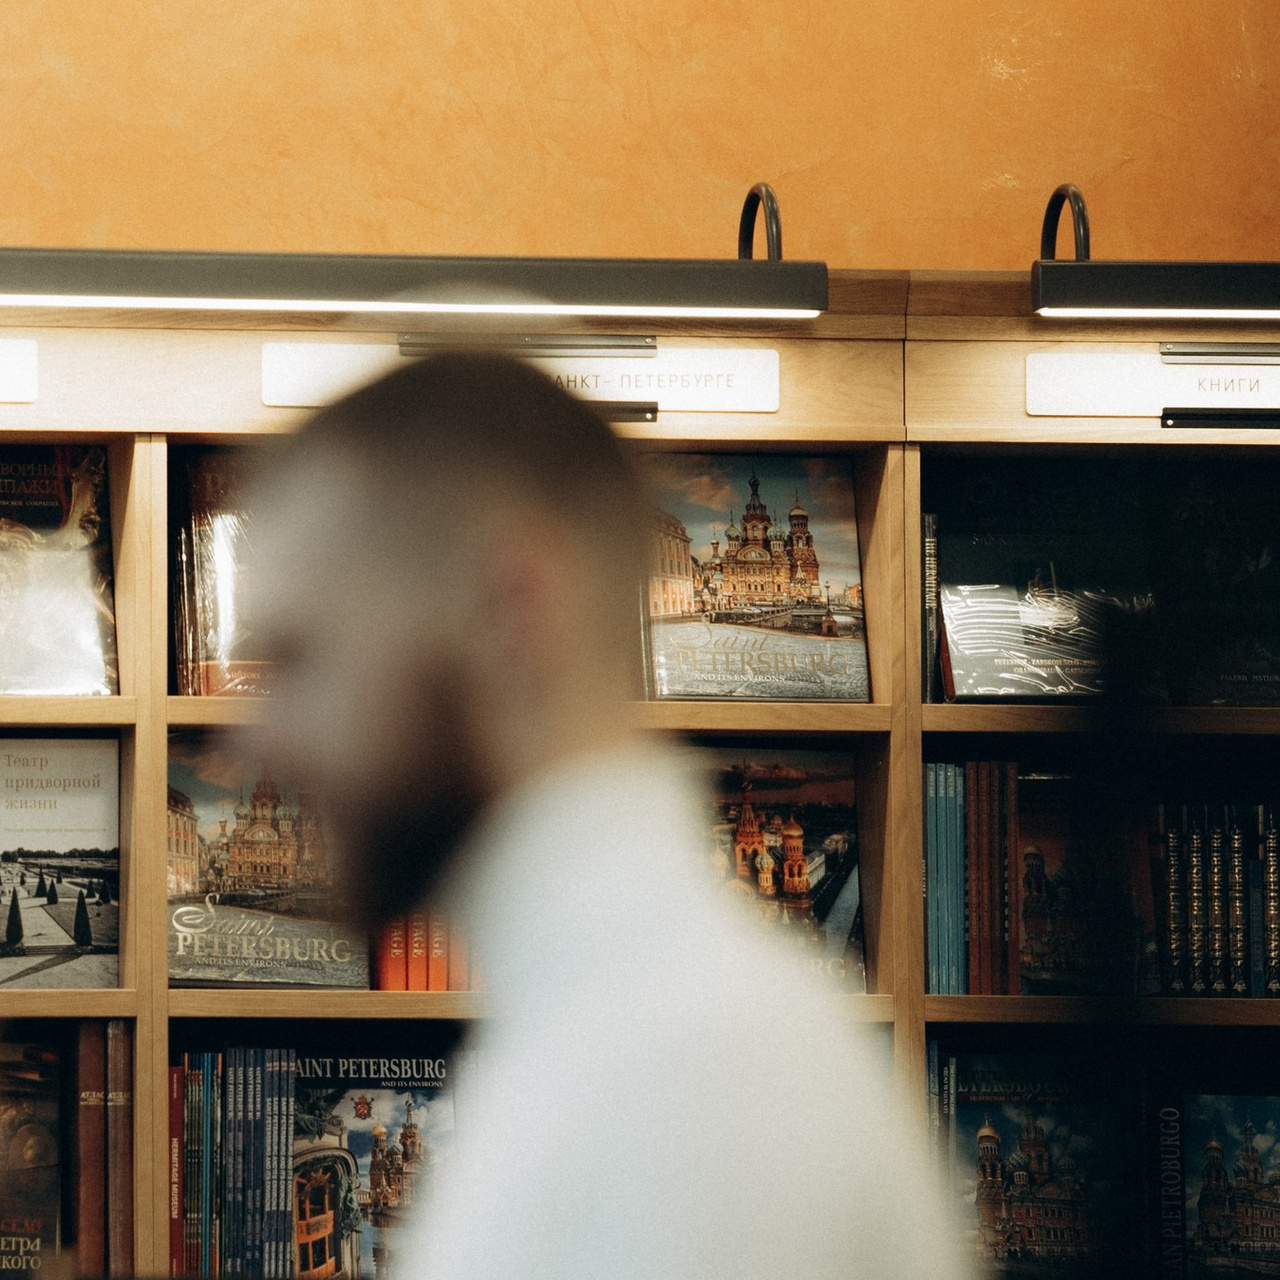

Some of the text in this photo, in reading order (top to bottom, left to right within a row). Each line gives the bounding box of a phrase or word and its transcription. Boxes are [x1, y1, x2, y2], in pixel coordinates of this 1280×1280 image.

[619, 373, 736, 390] ПЕТЕРБУРГЕ
[1197, 377, 1261, 393] КНИГИ
[675, 650, 851, 674] PETERSBURG
[4, 753, 49, 771] Театр
[4, 774, 101, 792] придворной
[4, 798, 58, 810] жизни
[172, 892, 276, 936] Saint
[175, 932, 352, 962] PETERSBURG
[236, 959, 287, 968] ENVIRONS
[295, 1057, 447, 1079] AINT PETERSBURG
[409, 1080, 443, 1088] ENVIRONS
[170, 1137, 179, 1219] HERMITAGE MUSEUM
[1159, 1107, 1183, 1238] PIETROBURGO
